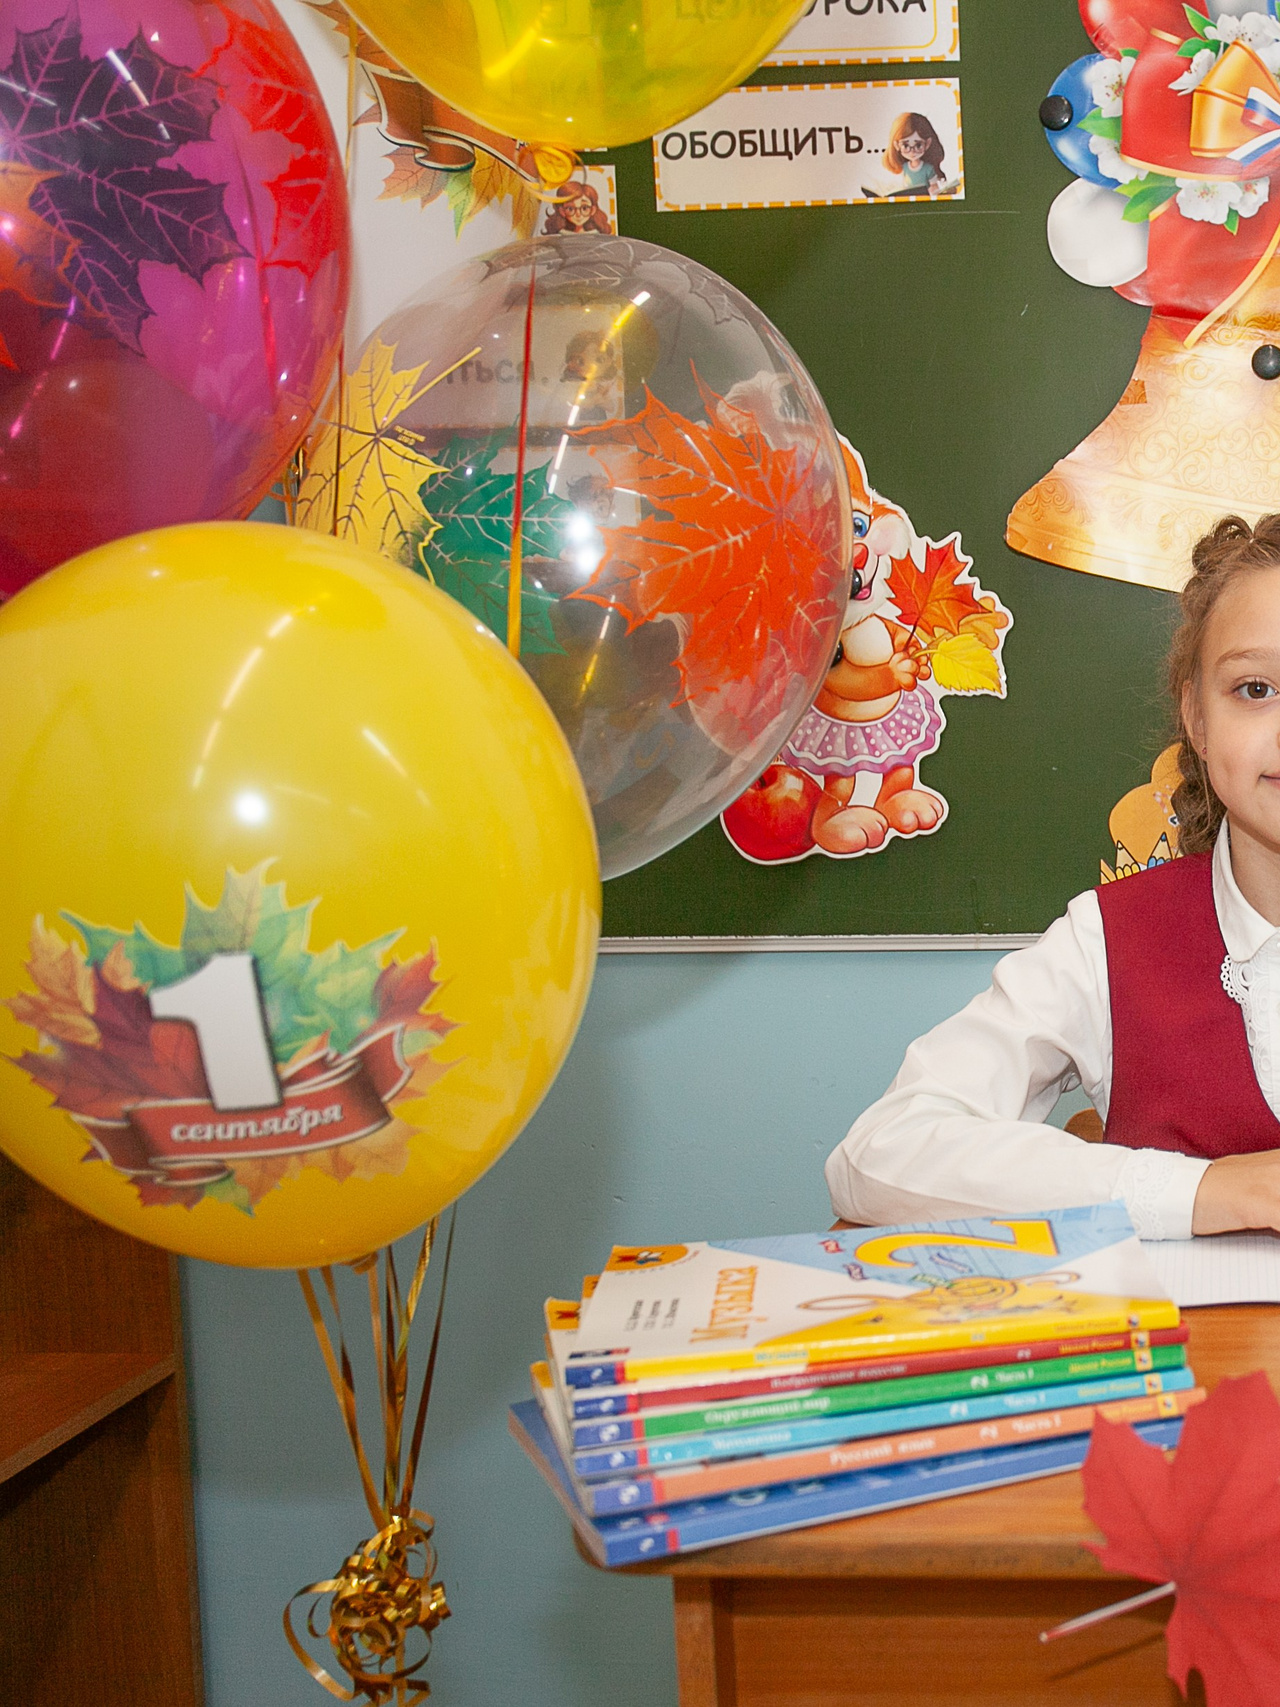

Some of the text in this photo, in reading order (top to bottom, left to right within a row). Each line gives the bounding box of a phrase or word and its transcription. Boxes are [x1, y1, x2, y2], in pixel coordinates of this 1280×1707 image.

[661, 126, 886, 160] ОБОБЩИТЬ...
[148, 951, 283, 1111] 1
[170, 1103, 344, 1143] сентября
